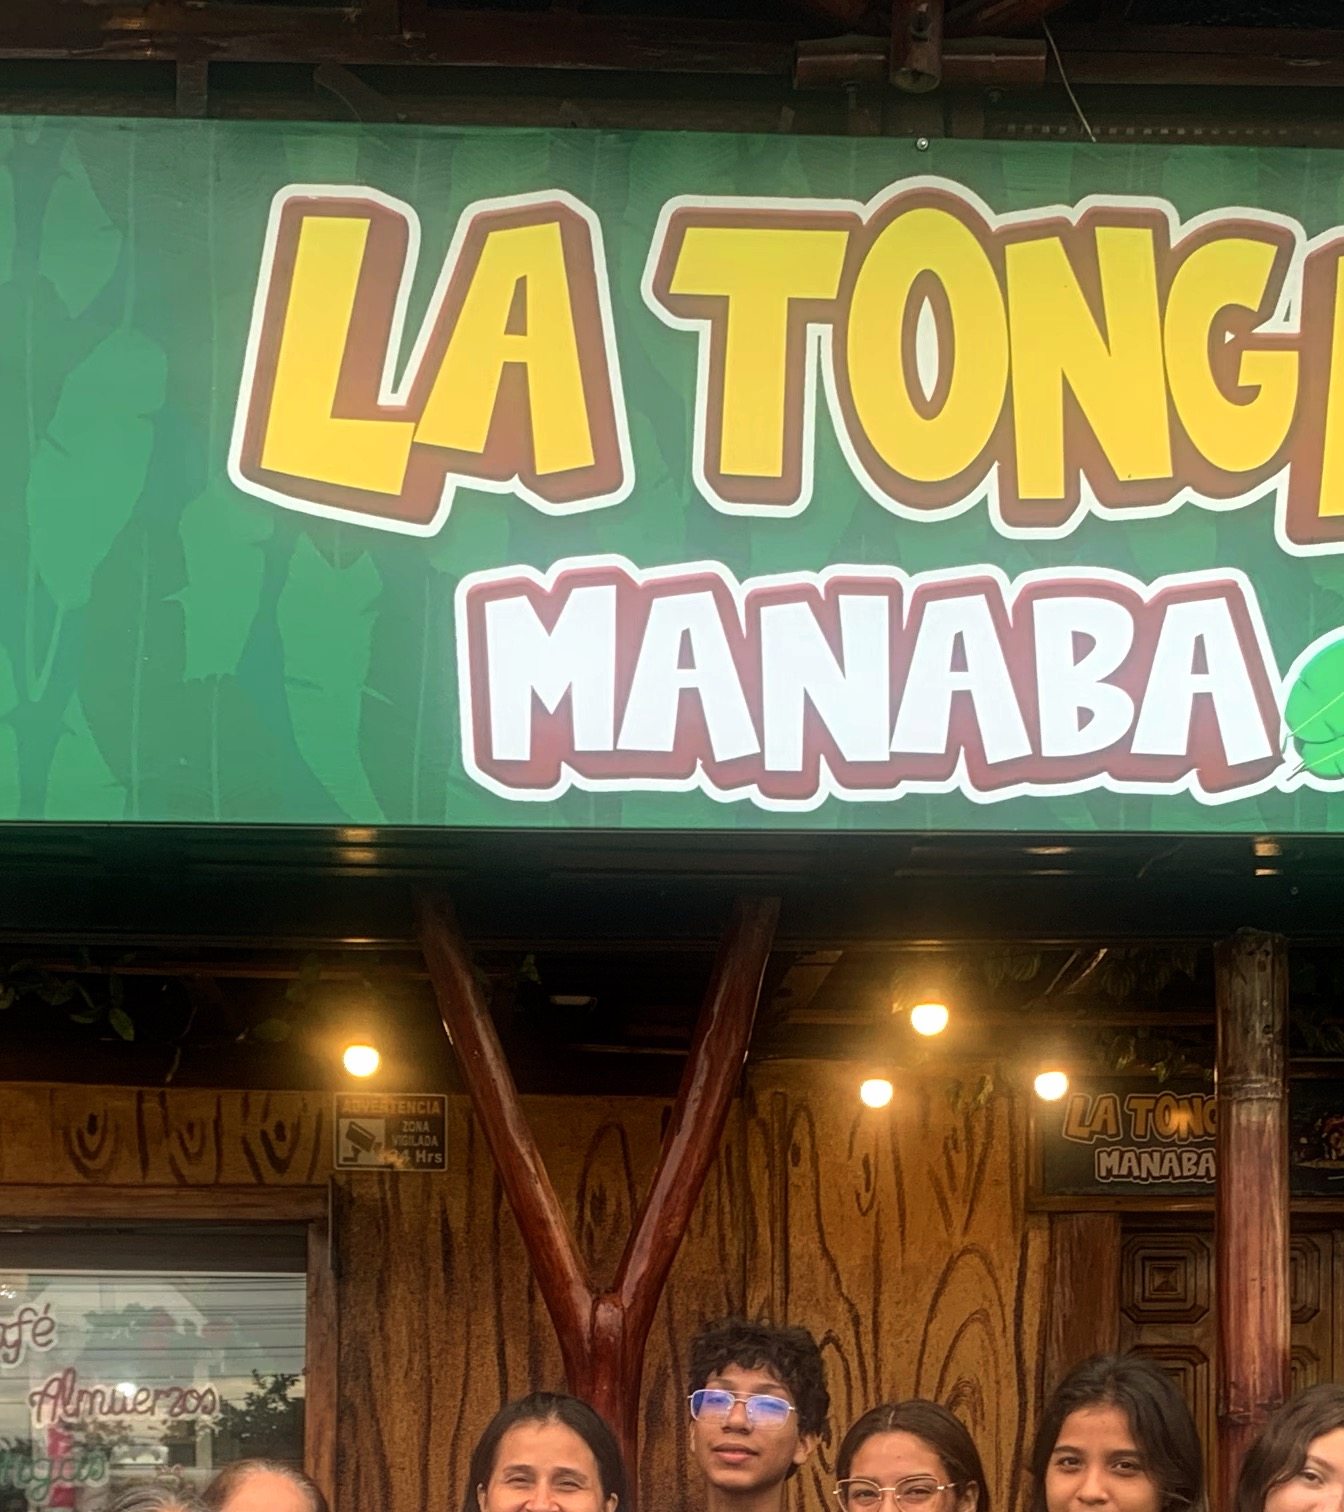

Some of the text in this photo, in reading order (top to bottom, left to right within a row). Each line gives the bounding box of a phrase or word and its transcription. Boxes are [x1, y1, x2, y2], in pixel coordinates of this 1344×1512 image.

[234, 190, 626, 532] LA
[462, 562, 1284, 796] MANABA
[402, 1121, 430, 1132] ZONA
[1065, 1095, 1121, 1141] LA
[391, 1135, 438, 1147] VIGILADA
[416, 1150, 443, 1164] Hrs
[1097, 1149, 1216, 1182] MANABA
[30, 1367, 218, 1424] Almuerzos
